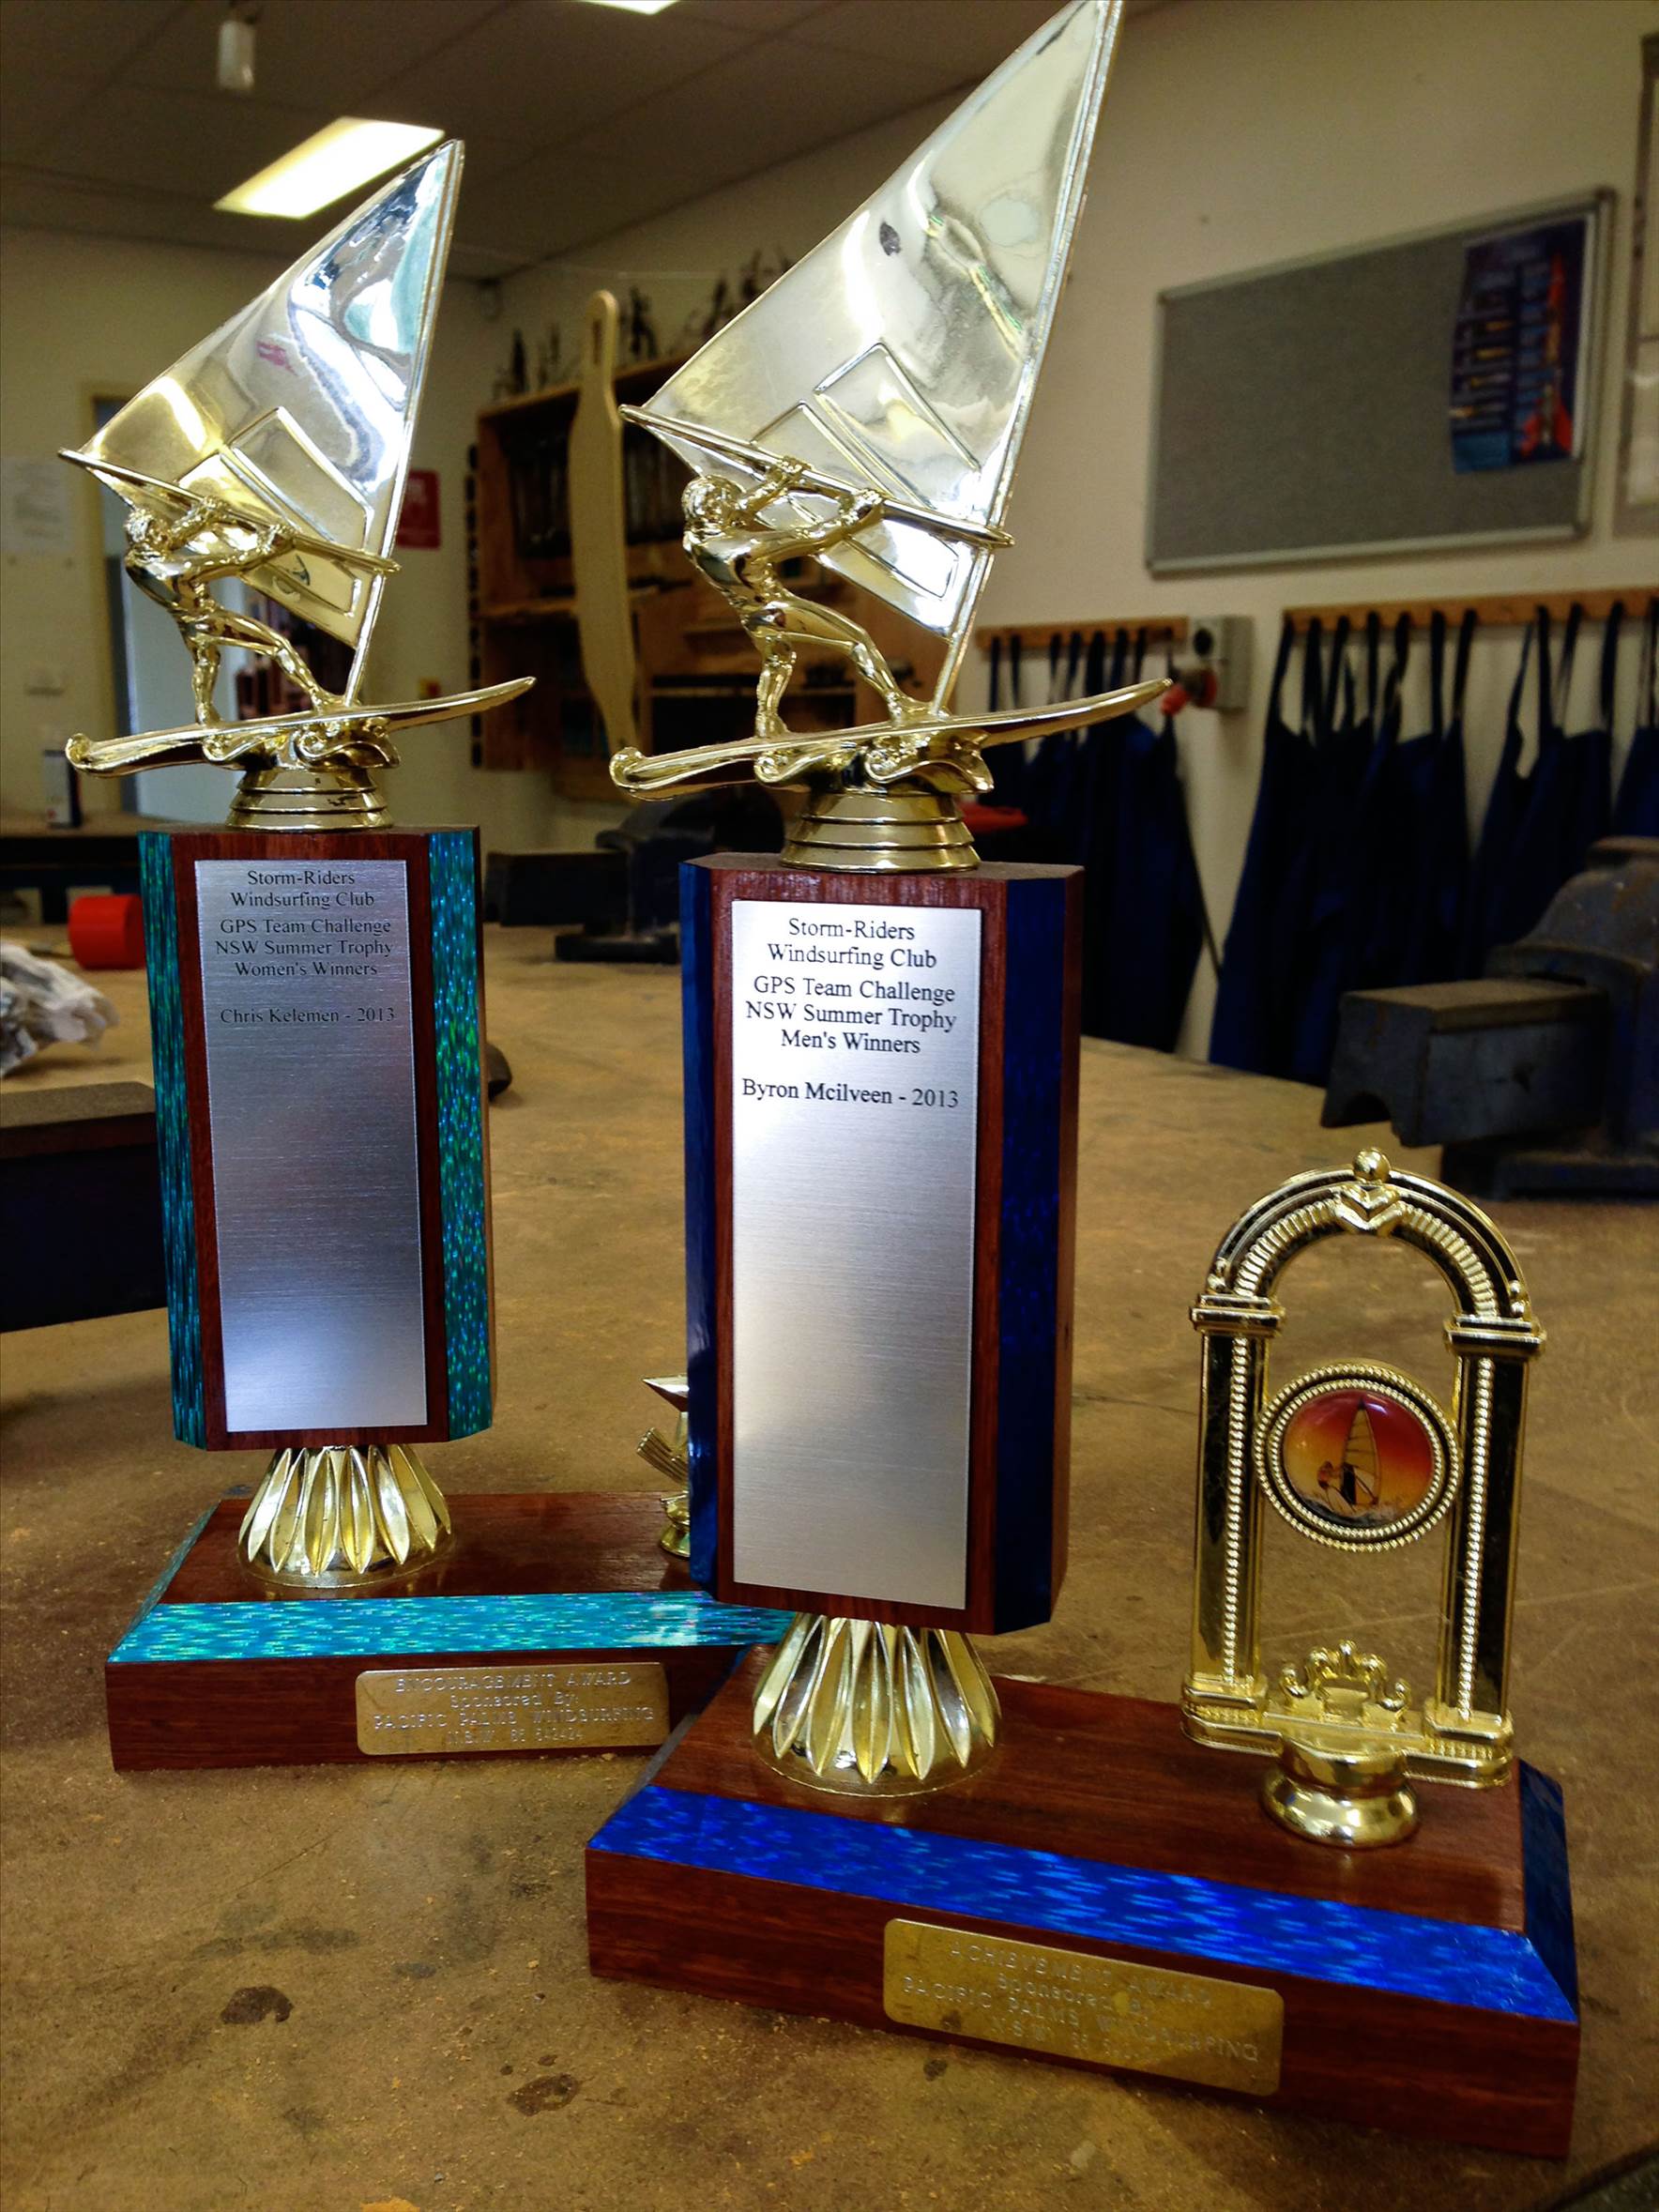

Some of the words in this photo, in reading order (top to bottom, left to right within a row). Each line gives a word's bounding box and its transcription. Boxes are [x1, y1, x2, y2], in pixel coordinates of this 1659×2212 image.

[248, 869, 356, 886] Storm-Riders
[230, 892, 330, 910] Windsurfing
[335, 891, 375, 907] Club
[220, 919, 258, 934] GPS
[263, 919, 305, 934] Team
[311, 918, 391, 937] Challenge
[787, 917, 916, 940] Storm-Riders
[215, 939, 258, 955] NSW
[264, 939, 331, 955] Summer
[337, 939, 392, 958] Trophy
[767, 942, 885, 970] Windsurfing
[890, 948, 937, 969] Club
[234, 961, 307, 977] Women's
[312, 961, 378, 977] Winners
[753, 975, 797, 995] GPS
[802, 977, 853, 998] Team
[859, 980, 956, 1007] Challenge
[221, 1008, 264, 1023] Chris
[268, 1008, 340, 1023] Kelemen
[356, 1006, 396, 1023] 2013
[745, 1000, 798, 1021] NSW
[803, 1003, 883, 1026] Summer
[887, 1007, 957, 1033] Trophy
[780, 1029, 837, 1050] Men's
[842, 1031, 922, 1054] Winners
[741, 1078, 799, 1101] Byron
[804, 1081, 893, 1106] Mcilveen
[911, 1088, 960, 1108] 2013
[394, 1673, 556, 1693] ENCOURAGEMENT
[565, 1670, 632, 1688] AWARD
[449, 1693, 542, 1712] Sponsored
[373, 1712, 449, 1731] PACIFIC
[459, 1710, 518, 1730] PALMS
[532, 1706, 654, 1724] WINDSURFING
[949, 1940, 1112, 1989] ACHIEVEMENT
[903, 1974, 993, 2010] PACIFIC
[1007, 1995, 1080, 2029] PALMS
[997, 1972, 1115, 2013] Sponsored
